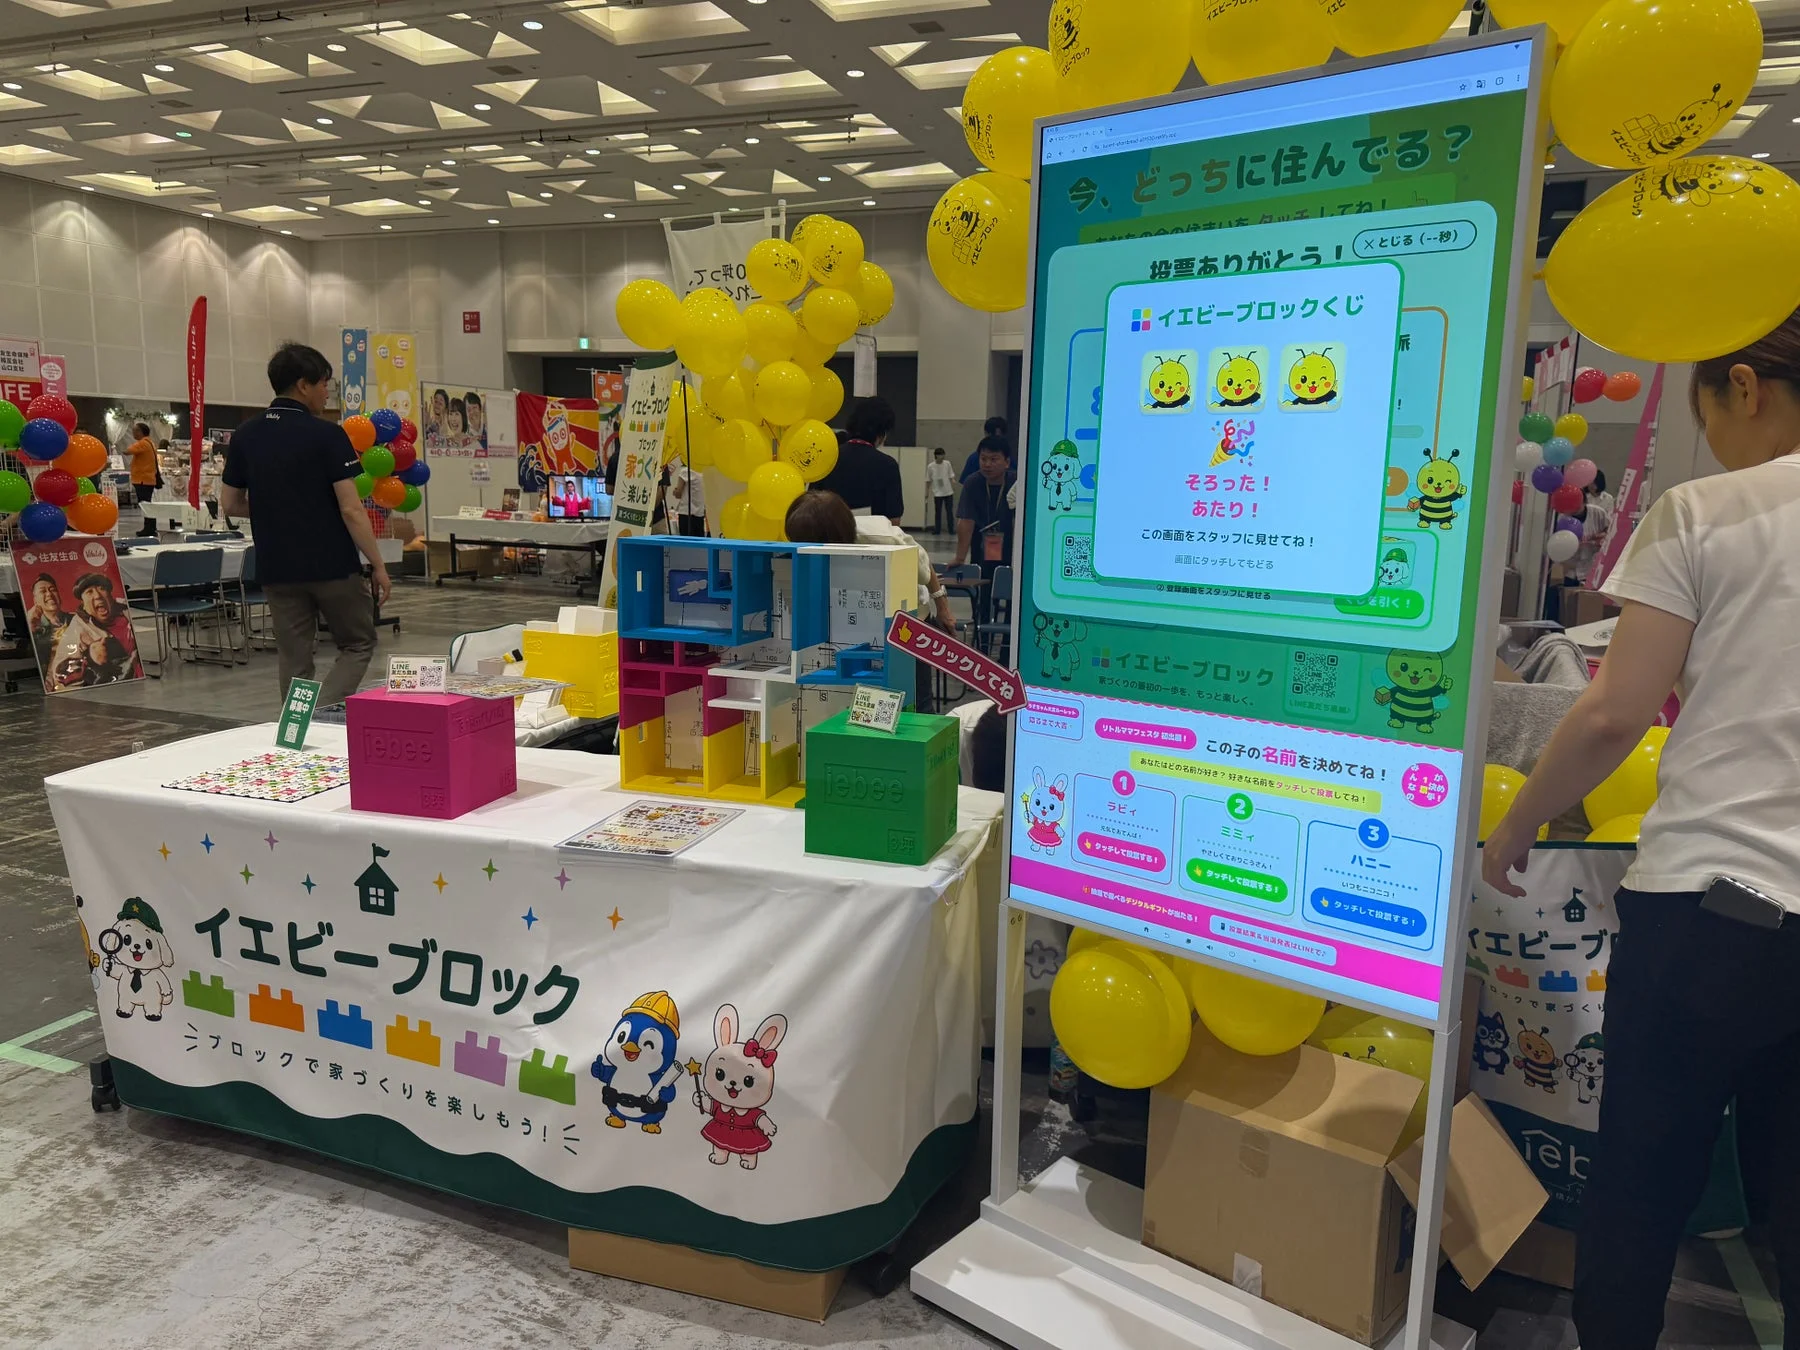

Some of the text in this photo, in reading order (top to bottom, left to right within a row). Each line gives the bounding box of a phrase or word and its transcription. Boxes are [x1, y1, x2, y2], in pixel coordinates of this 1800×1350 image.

[1069, 125, 1472, 213] 今、どっちに住んでる？
[971, 217, 998, 266] イエビーブロック
[1158, 295, 1364, 328] イエビーブロックくじ
[625, 453, 658, 481] 家づく
[1185, 473, 1270, 492] そろった！
[627, 484, 652, 505] 楽しも
[1192, 501, 1258, 518] あたり！
[1141, 528, 1314, 548] この画面をスタッフに見せてね！
[39, 551, 79, 563] 住友生命
[1175, 554, 1274, 570] 画面にタッチしてもどる
[915, 633, 1016, 701] クリックしてね
[1115, 652, 1274, 687] イエビーブロック
[293, 686, 314, 702] 友だち
[1098, 675, 1255, 706] 家づくりの最初の一歩を、もっと楽しく。
[1206, 739, 1386, 781] この子の名前を決めてね！
[1107, 801, 1137, 817] ラビィ
[1220, 825, 1255, 842] ミミィ
[1350, 854, 1391, 869] ハニー
[1341, 881, 1395, 898] いつもニコニコ！
[194, 907, 581, 1026] イエビーブロック
[208, 1034, 549, 1143] ブロックで家づくりを楽しもう！
